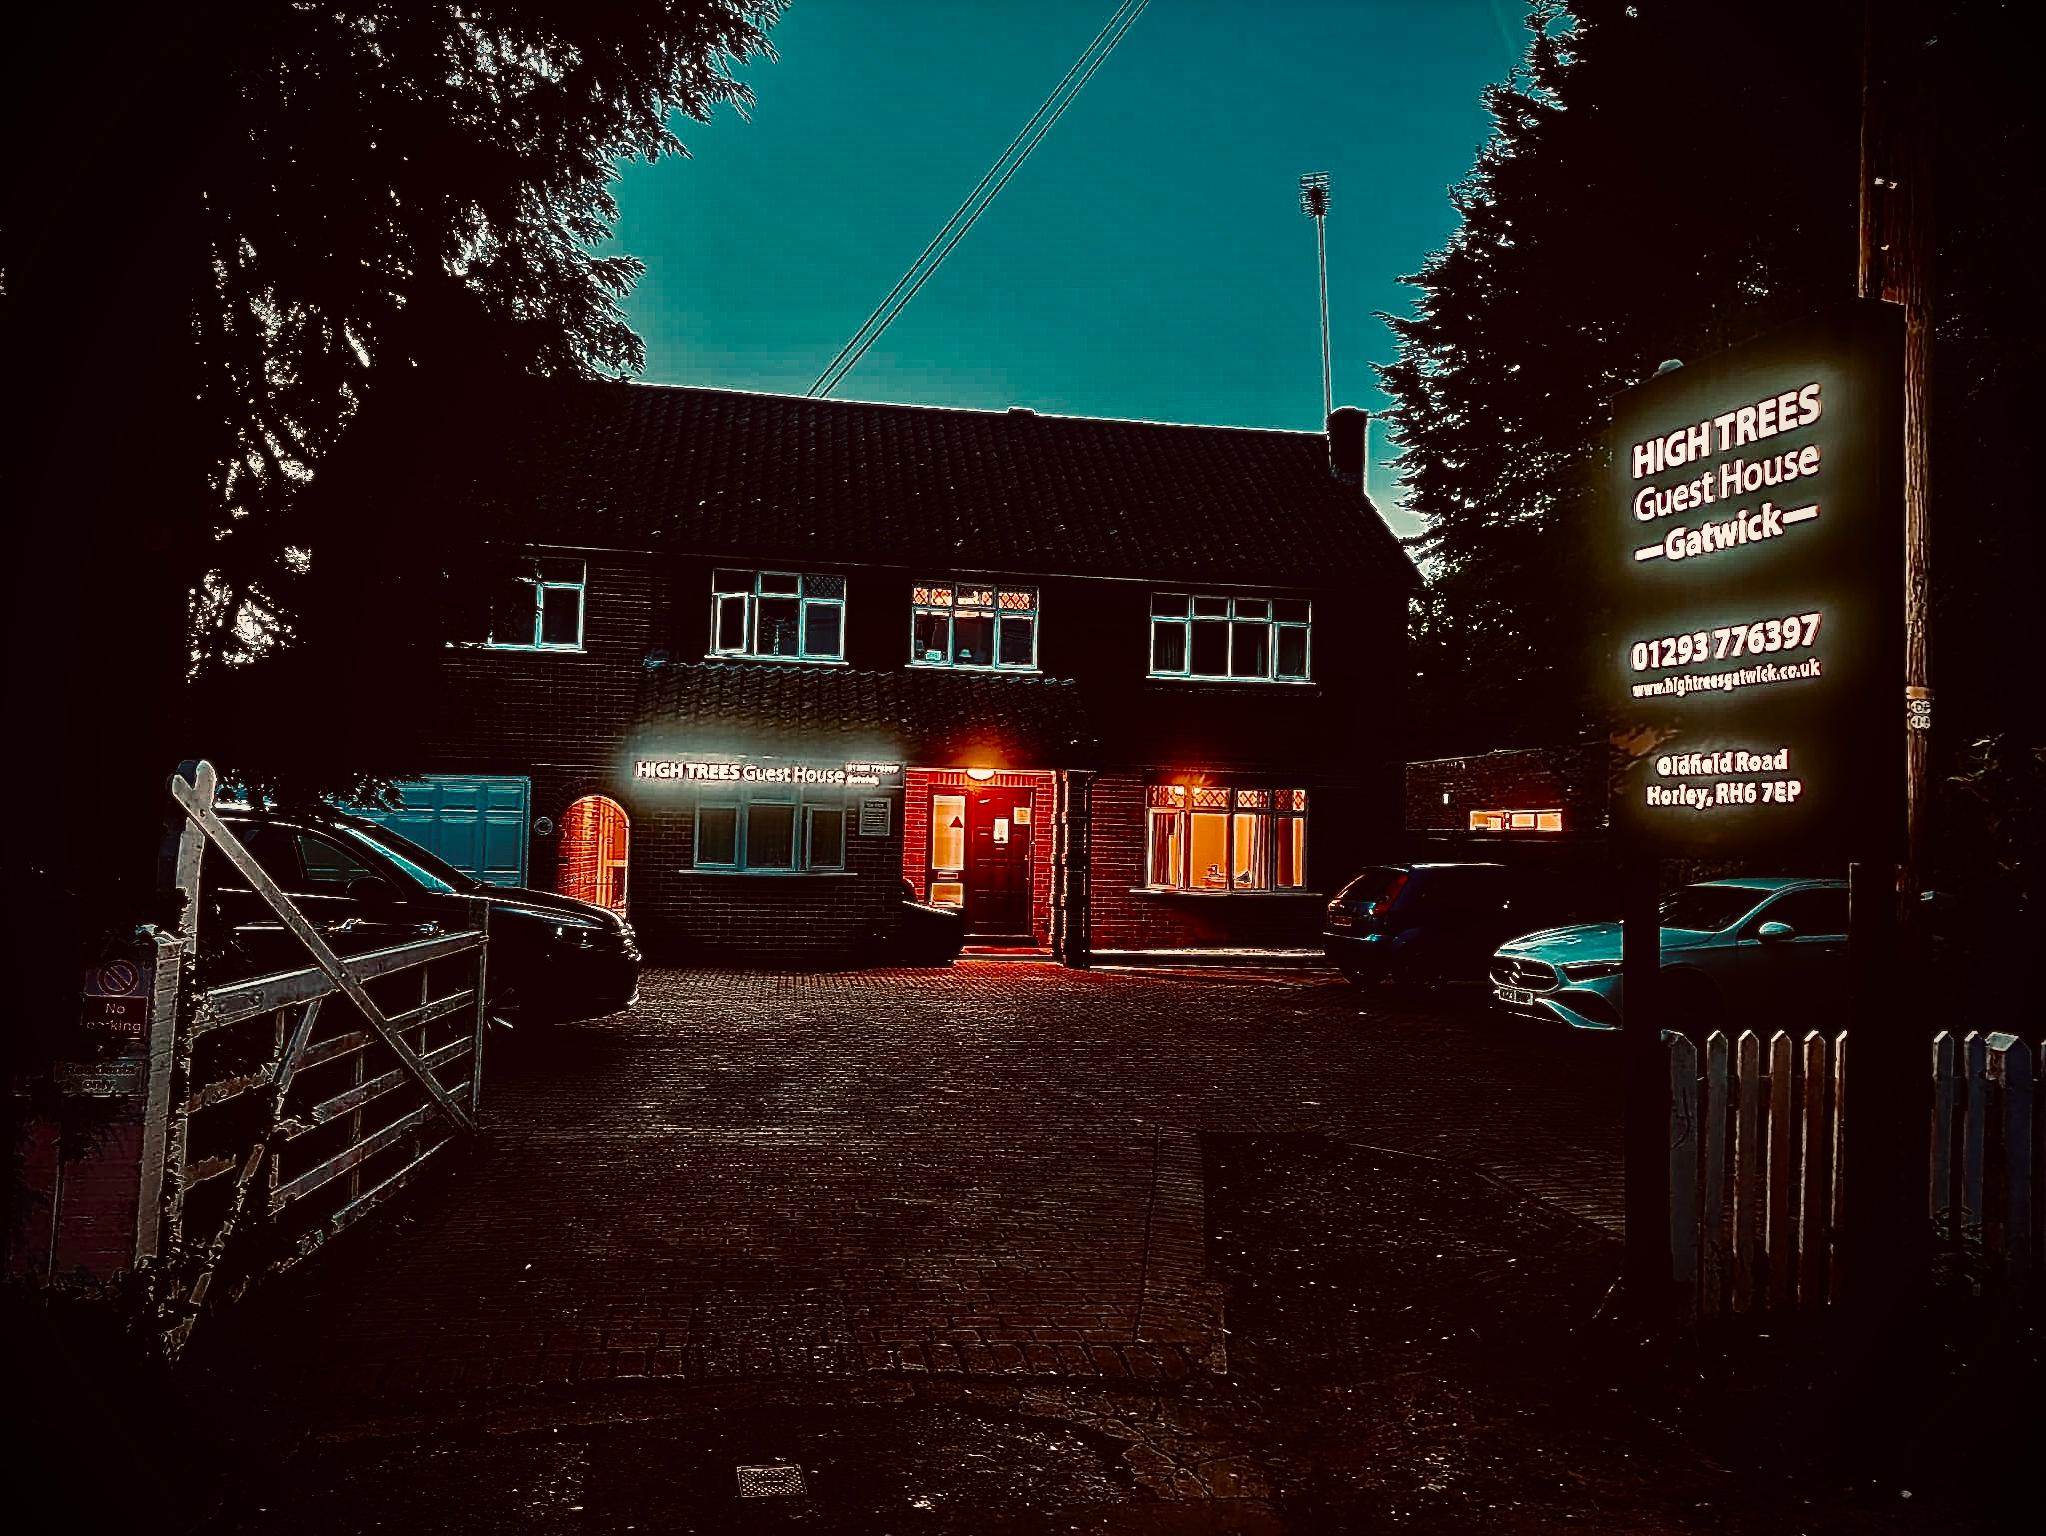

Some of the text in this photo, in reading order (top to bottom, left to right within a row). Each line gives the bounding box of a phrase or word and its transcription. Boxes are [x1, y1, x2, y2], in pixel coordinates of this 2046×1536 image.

[1632, 383, 1822, 479] HIGH TREES
[1634, 445, 1821, 521] Guest House
[1664, 502, 1784, 560] Gatwick
[1631, 612, 1822, 671] 01293 776397
[1632, 658, 1821, 698] www.hightreesgatwick.co.uk
[636, 761, 685, 779] HIGH
[686, 763, 740, 781] TREES
[742, 765, 791, 783] Guest
[793, 766, 846, 785] House
[1656, 749, 1788, 776] Oldfield Road
[1646, 780, 1802, 809] Horley, RH6 7EP
[105, 1003, 125, 1014] No
